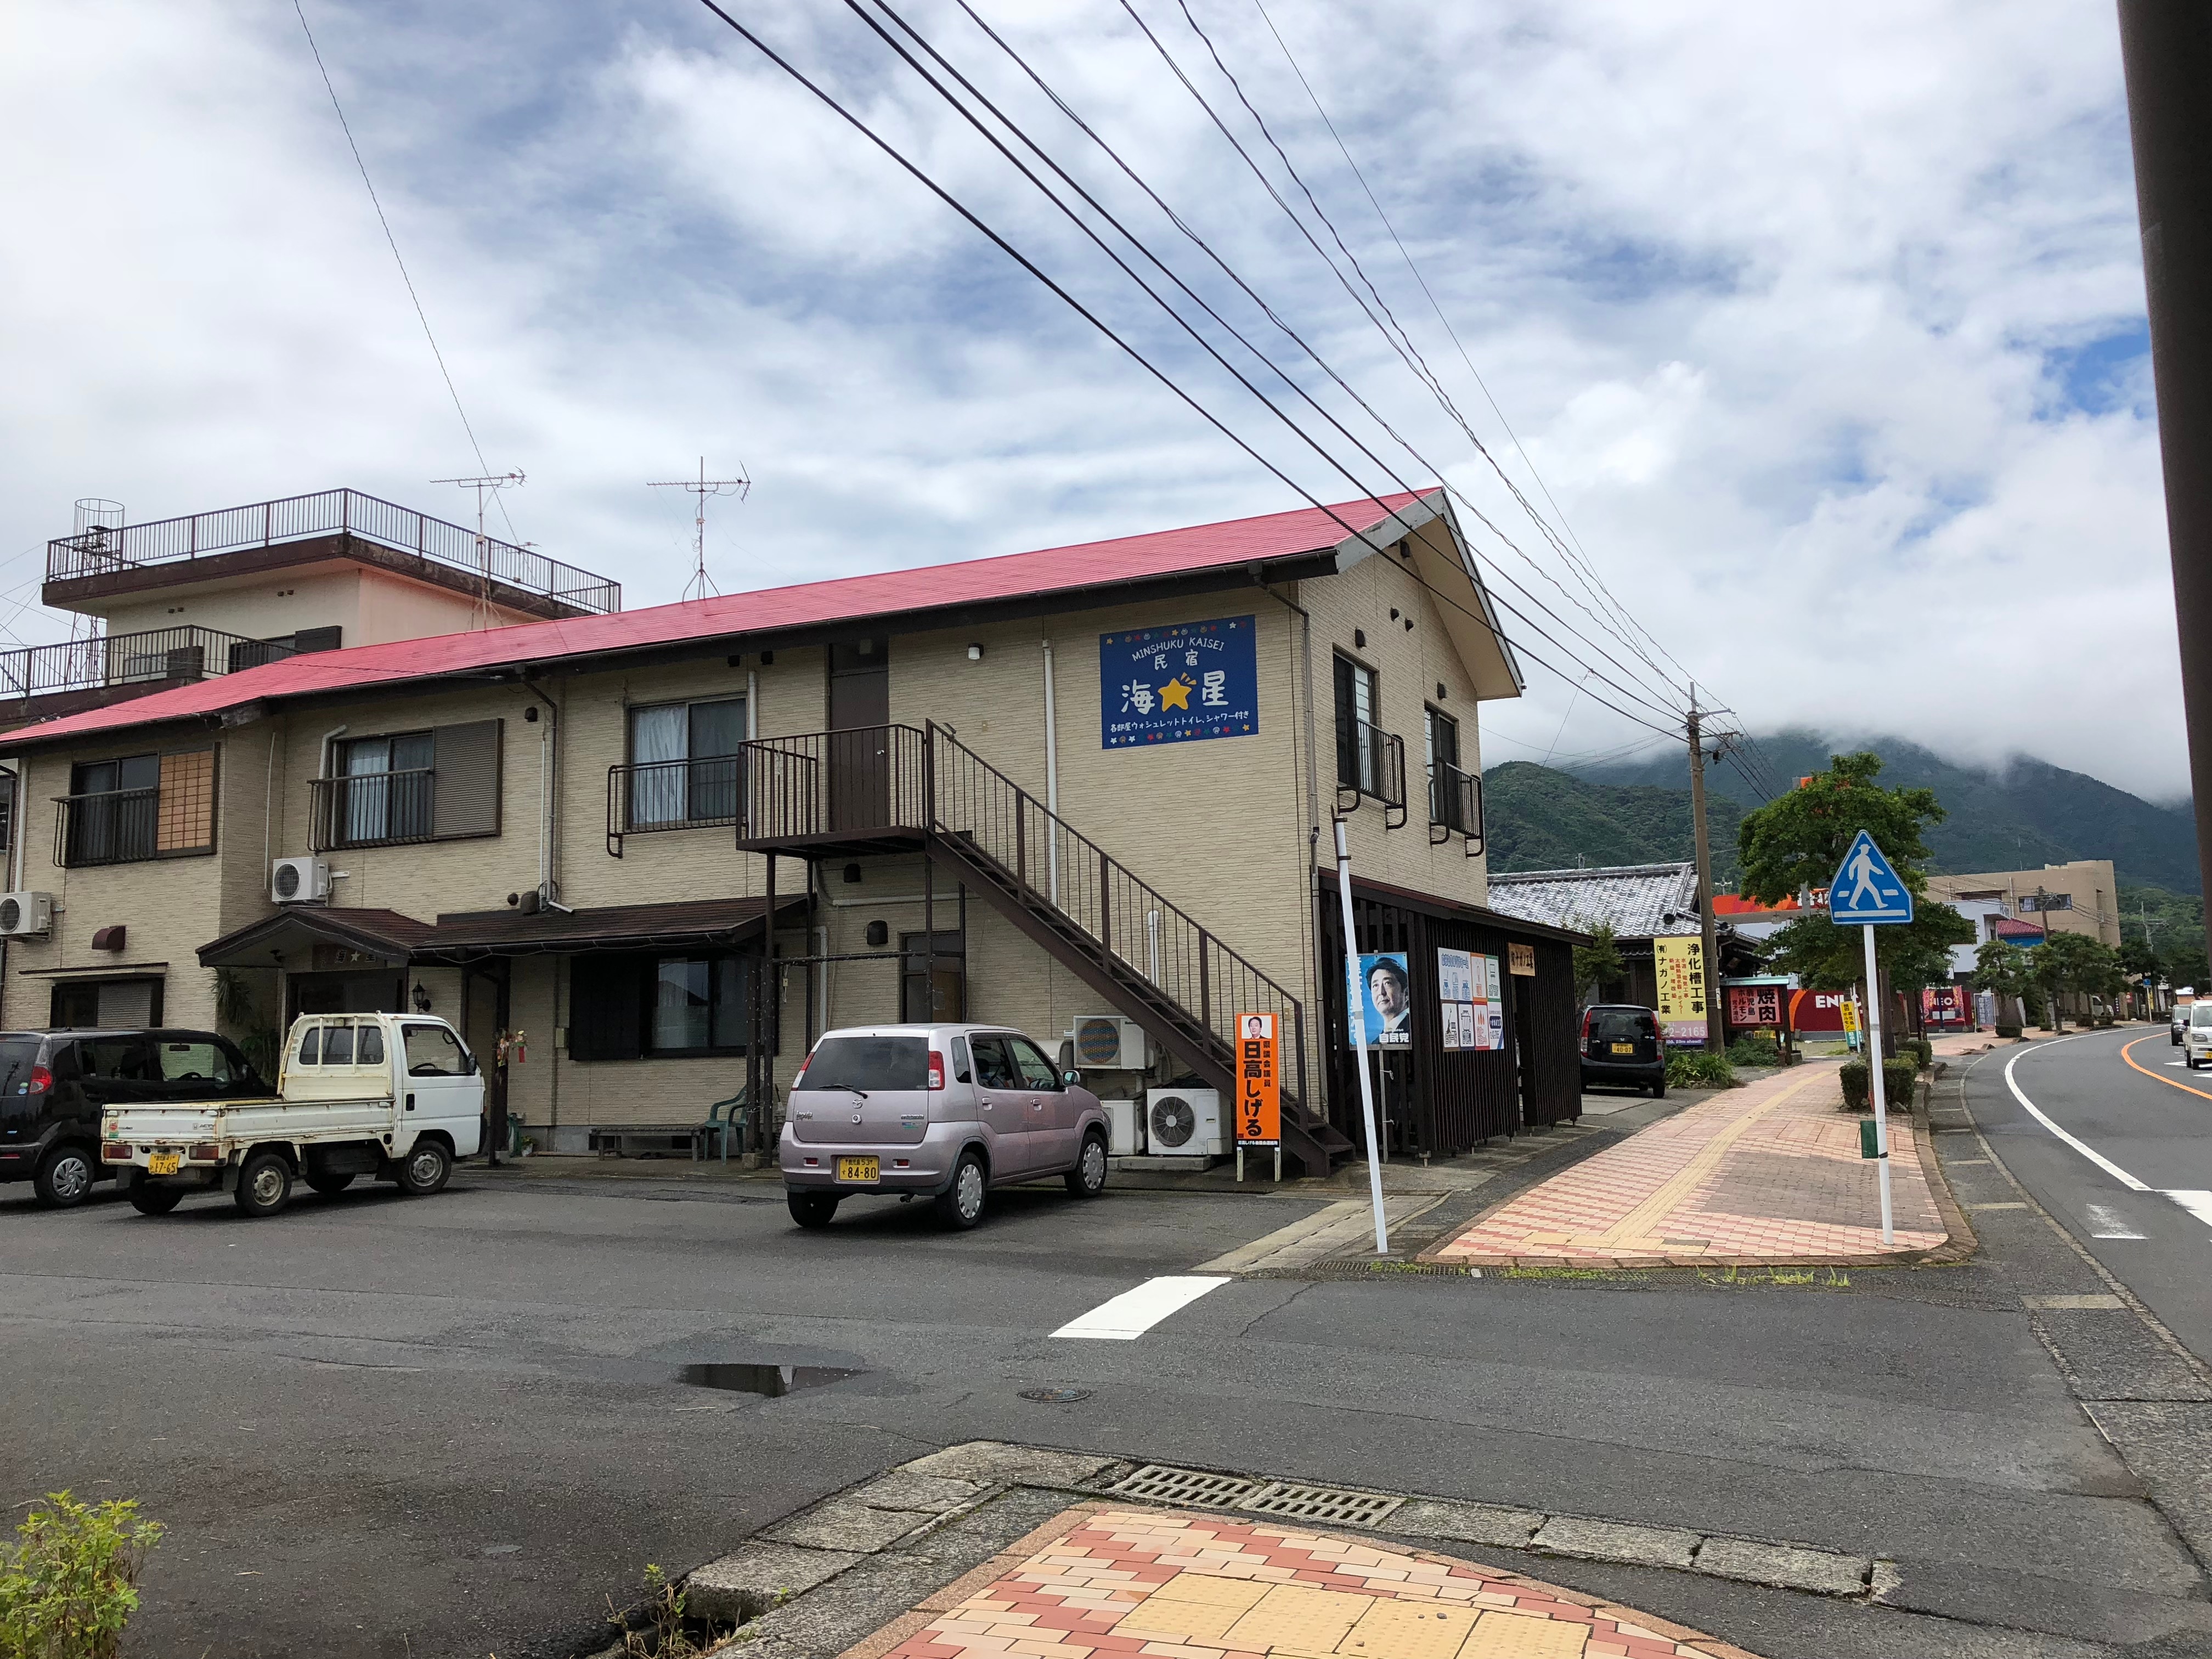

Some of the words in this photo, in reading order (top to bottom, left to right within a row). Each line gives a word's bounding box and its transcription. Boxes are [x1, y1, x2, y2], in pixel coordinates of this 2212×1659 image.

[1132, 639, 1183, 662] MINSHUKU
[1189, 637, 1224, 651] KAISEI
[1688, 943, 1705, 1014] 浄化槽工事
[1738, 989, 1747, 1021] ホルモン
[1757, 989, 1776, 1022] 焼肉
[1379, 1033, 1409, 1042] 自民党
[1243, 1041, 1263, 1137] 日高しげる
[848, 1166, 876, 1178] 84-80
